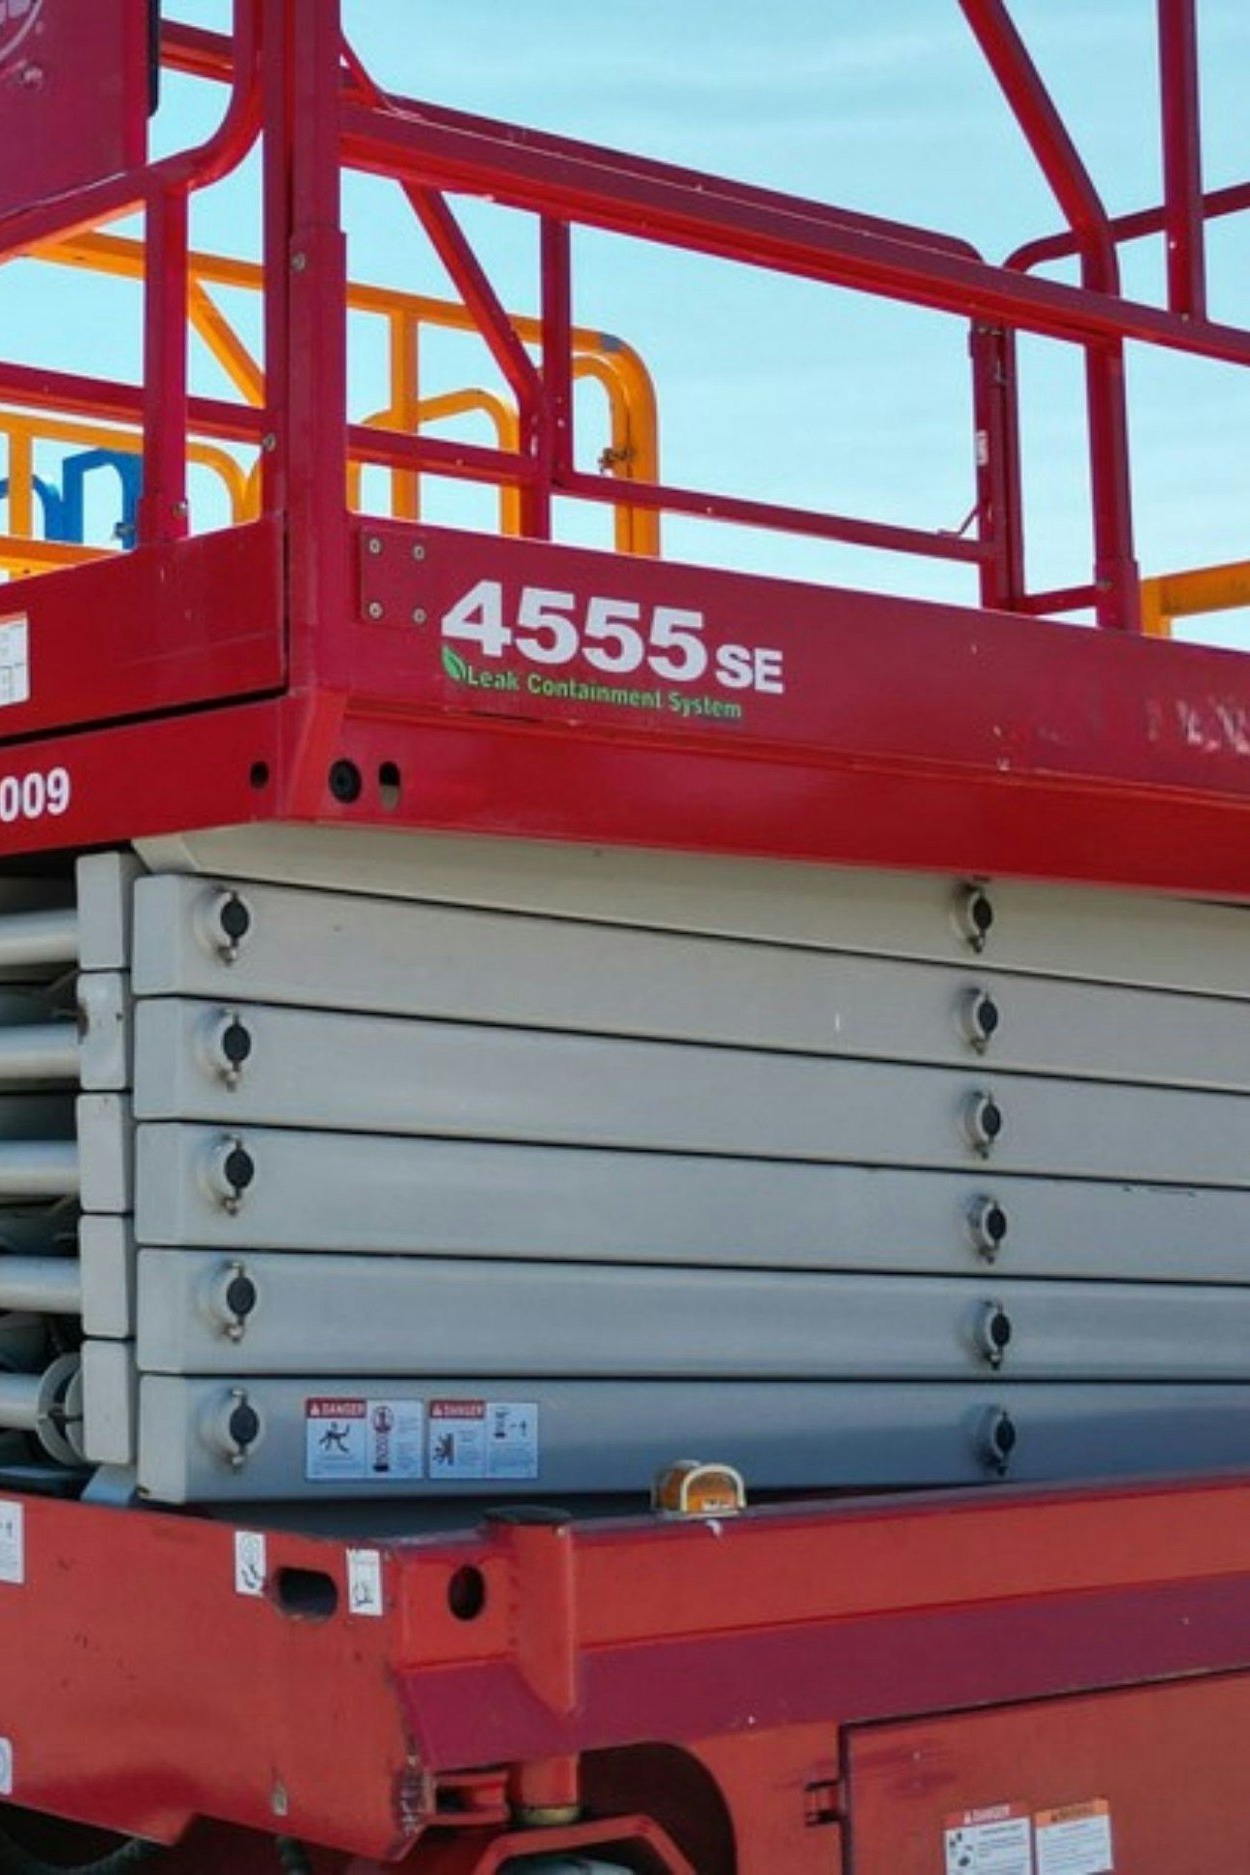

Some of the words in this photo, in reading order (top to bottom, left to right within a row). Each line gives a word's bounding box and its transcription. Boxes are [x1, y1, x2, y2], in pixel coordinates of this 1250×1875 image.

[441, 579, 707, 681] 4555
[715, 644, 784, 694] SE
[467, 664, 519, 691] Leak
[527, 673, 661, 709] Containment
[667, 691, 742, 718] System
